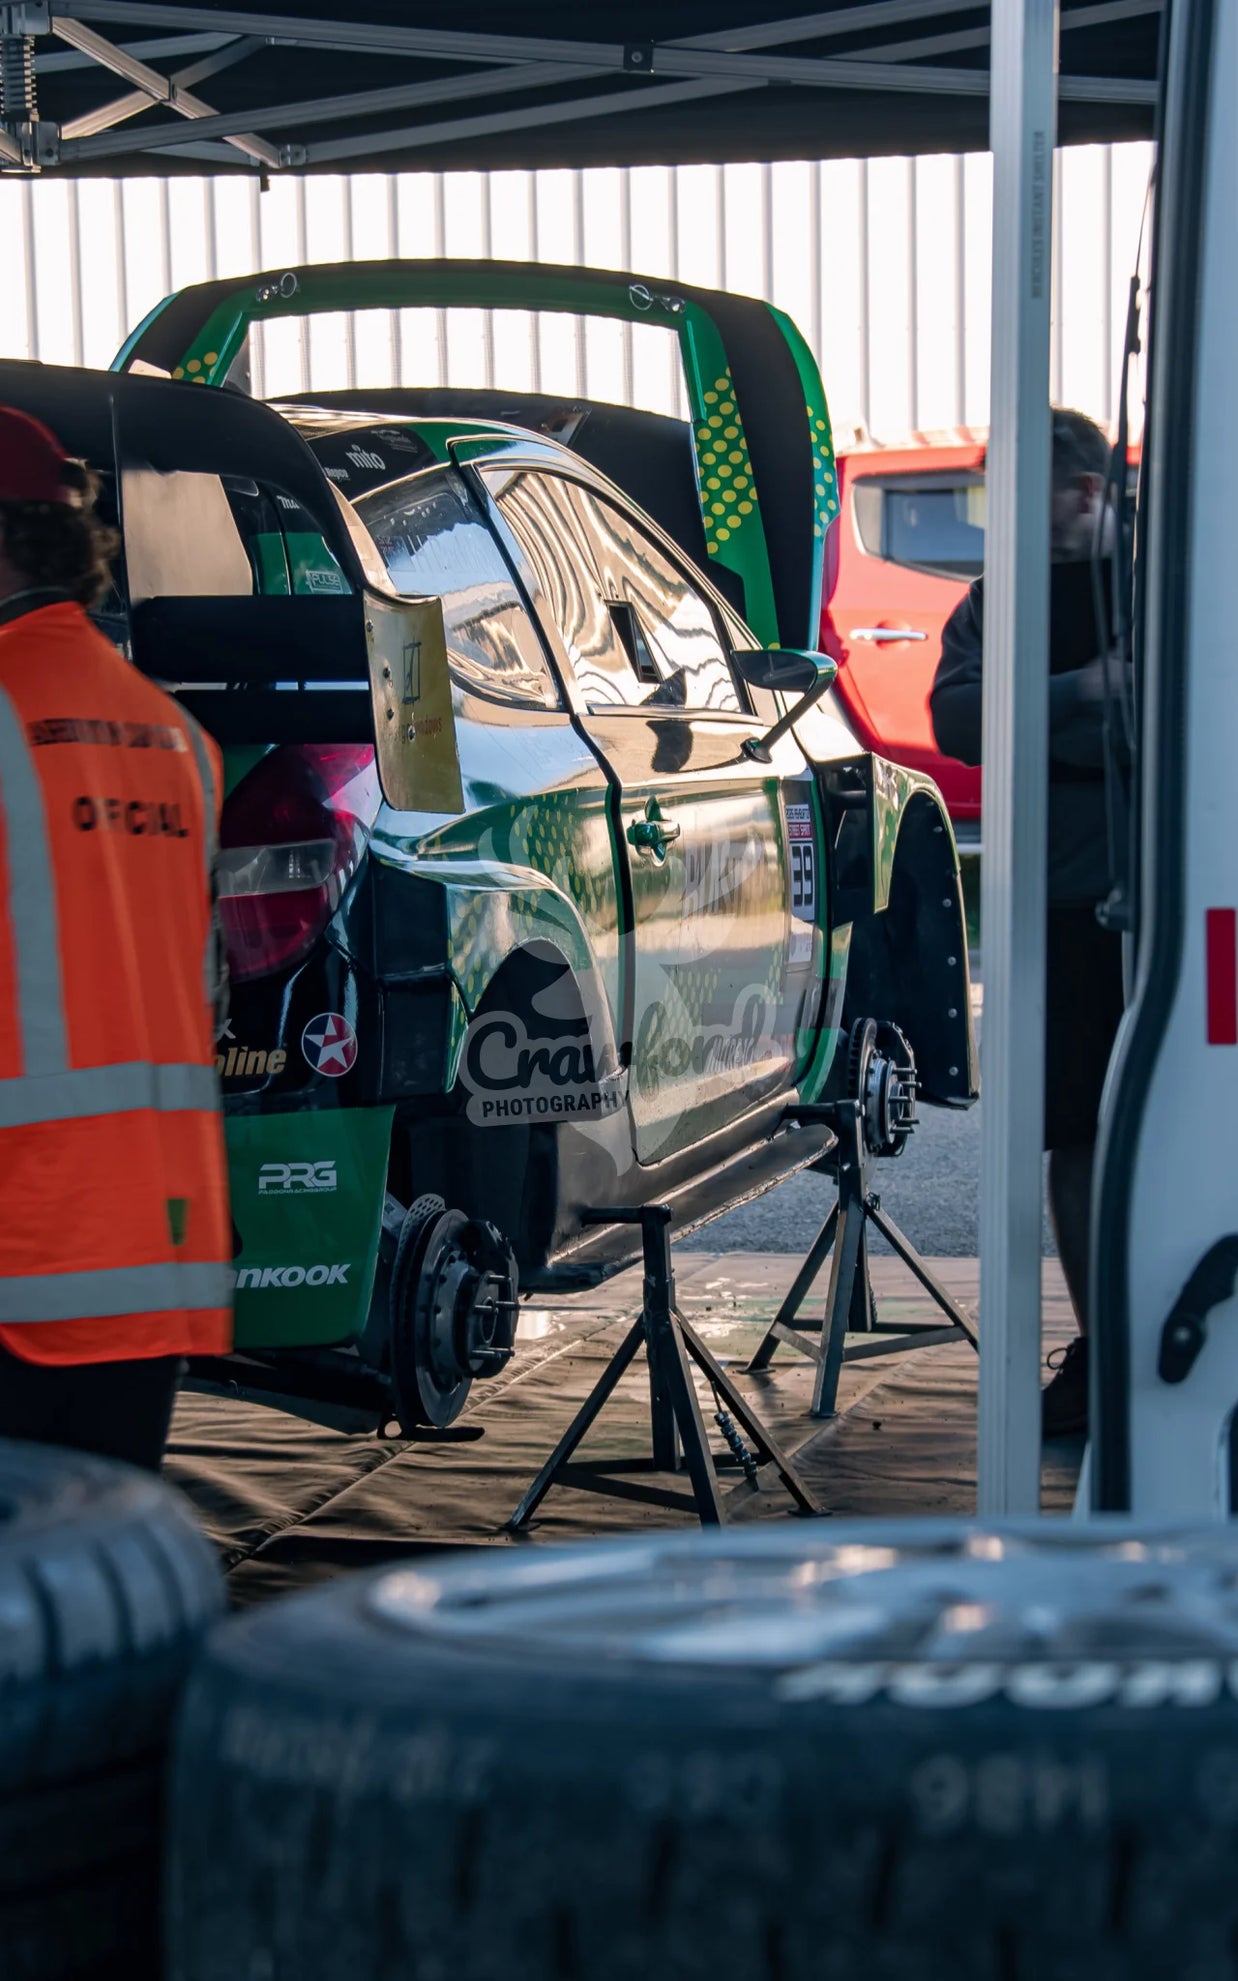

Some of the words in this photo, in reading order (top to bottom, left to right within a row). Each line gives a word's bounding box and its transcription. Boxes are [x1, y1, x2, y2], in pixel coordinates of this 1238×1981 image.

[792, 845, 813, 907] 39
[214, 1046, 287, 1077] oline
[258, 1161, 337, 1189] PRG
[235, 1263, 351, 1289] NKOOK
